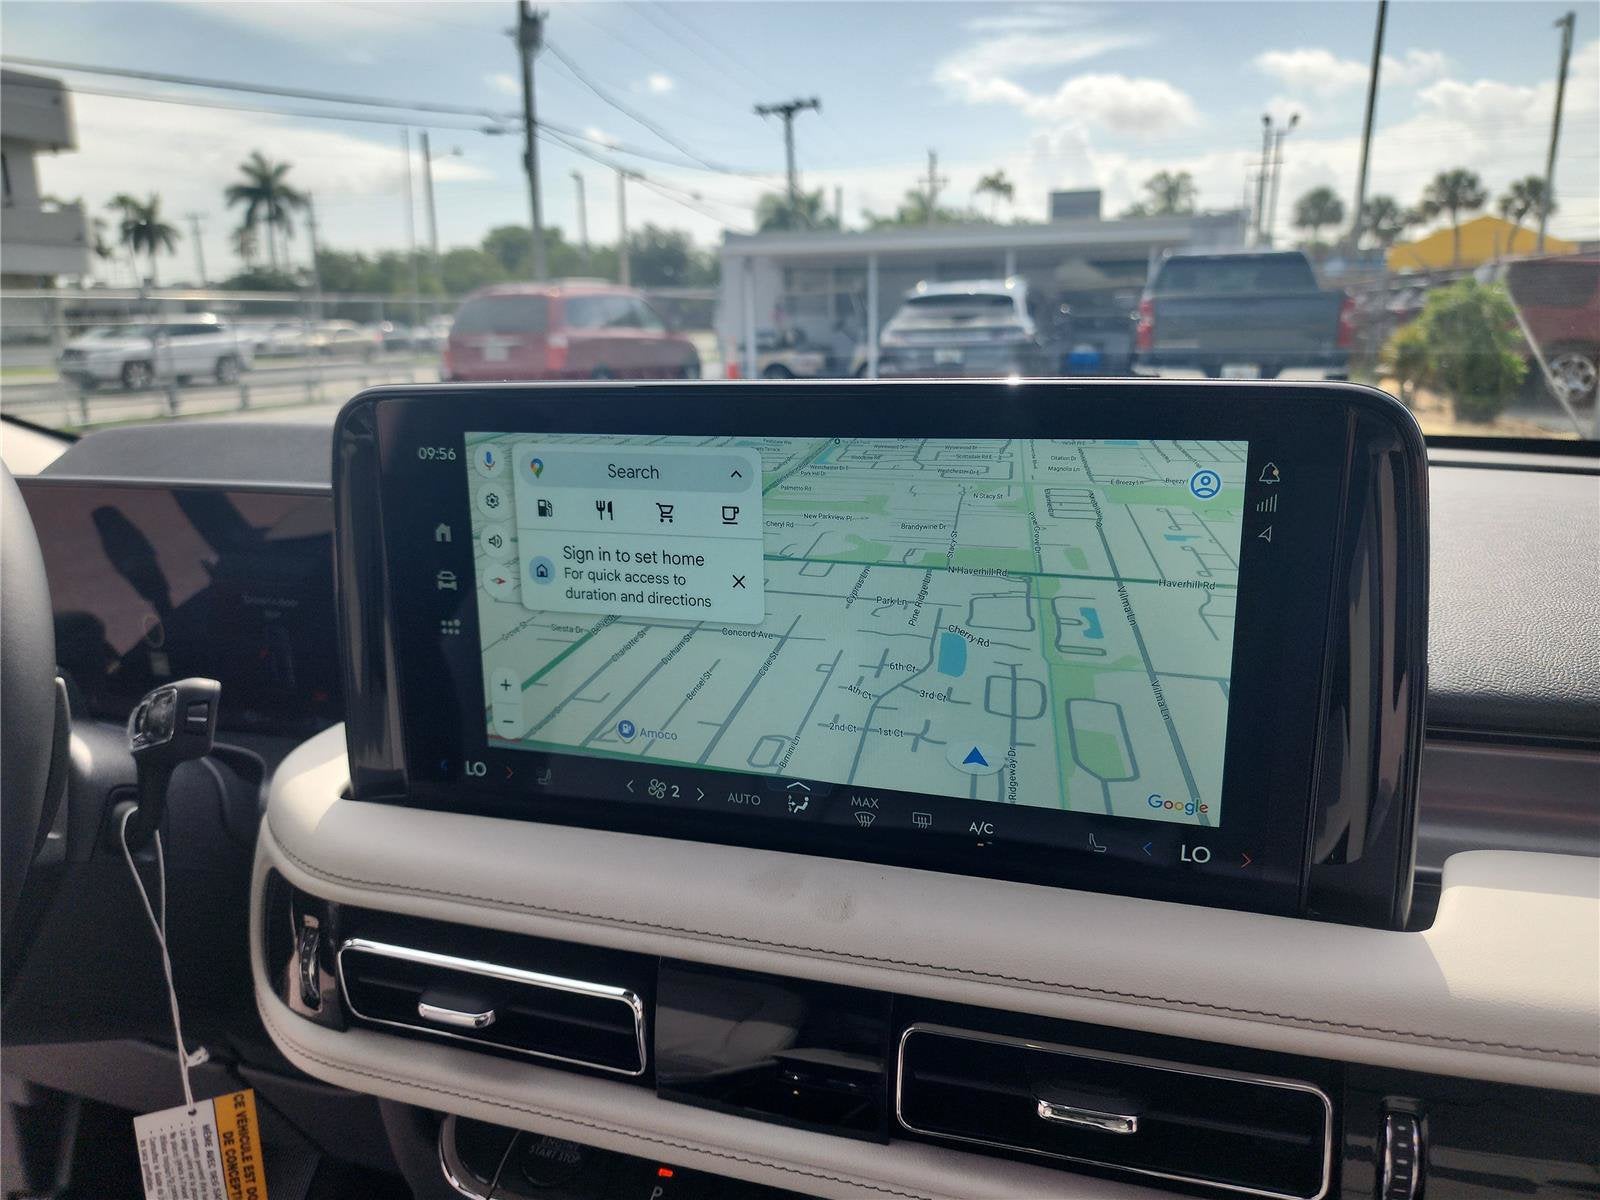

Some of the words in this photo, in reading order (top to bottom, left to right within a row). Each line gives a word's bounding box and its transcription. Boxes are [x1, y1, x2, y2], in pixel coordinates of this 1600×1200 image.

[418, 447, 456, 460] 09:56
[608, 464, 660, 479] Search
[766, 520, 784, 528] Cheryl
[901, 523, 937, 531] Brandywine
[562, 546, 594, 564] Sign
[598, 546, 611, 562] in
[616, 549, 630, 562] to
[634, 550, 658, 564] set
[662, 550, 705, 566] home
[564, 568, 584, 580] For
[588, 568, 621, 583] quick
[625, 573, 670, 585] access
[673, 574, 686, 586] to
[948, 566, 954, 574] N
[957, 566, 994, 575] Haverhill
[996, 568, 1008, 577] Rd
[846, 574, 864, 605] Cyprus
[862, 568, 870, 578] Ln
[1158, 578, 1200, 589] Haverhill
[1202, 581, 1216, 590] Rd
[566, 587, 616, 602] duration
[620, 590, 644, 603] and
[648, 592, 712, 608] directions
[876, 596, 895, 604] Park
[897, 597, 907, 606] Ln
[908, 608, 918, 627] Pine
[914, 583, 930, 609] Ridge
[924, 569, 932, 584] Ln
[1117, 586, 1130, 614] Vilma
[1126, 612, 1136, 626] Ln
[551, 624, 574, 632] Siesta
[574, 625, 584, 634] Dr
[722, 628, 757, 638] Concord
[758, 631, 774, 640] Ave
[948, 624, 976, 643] Cherry
[976, 637, 990, 648] Rd
[612, 635, 639, 662] Charlotte
[637, 629, 647, 640] St
[661, 640, 684, 665] Durham
[682, 634, 692, 644] St
[758, 658, 773, 677] Cole
[770, 650, 779, 662] St
[889, 662, 904, 672] 6th
[904, 664, 916, 672] Ct
[686, 676, 704, 701] Bensel
[702, 671, 712, 681] St
[848, 684, 862, 696] 4th
[862, 690, 872, 700] Ct
[920, 690, 934, 700] 3rd
[935, 692, 947, 702] Ct
[1151, 680, 1166, 708] Vilma
[1160, 705, 1170, 720] Ln
[640, 728, 678, 741] Amoco
[830, 722, 845, 732] 2nd
[845, 724, 857, 733] Ct
[878, 728, 892, 738] 1st
[892, 729, 904, 738] Ct
[780, 744, 795, 768] Bimini
[792, 735, 801, 747] Ln
[1008, 746, 1016, 757] Dr
[465, 760, 487, 776] LO
[1008, 758, 1017, 800] Ridgeway
[671, 786, 680, 798] 2
[728, 792, 761, 806] AUTO
[851, 796, 880, 809] MAX
[1148, 794, 1208, 816] Google
[969, 820, 994, 834] A/C
[1180, 844, 1211, 864] LO
[223, 1131, 235, 1146] DE
[233, 1094, 246, 1110] CE
[243, 1164, 256, 1184] EST
